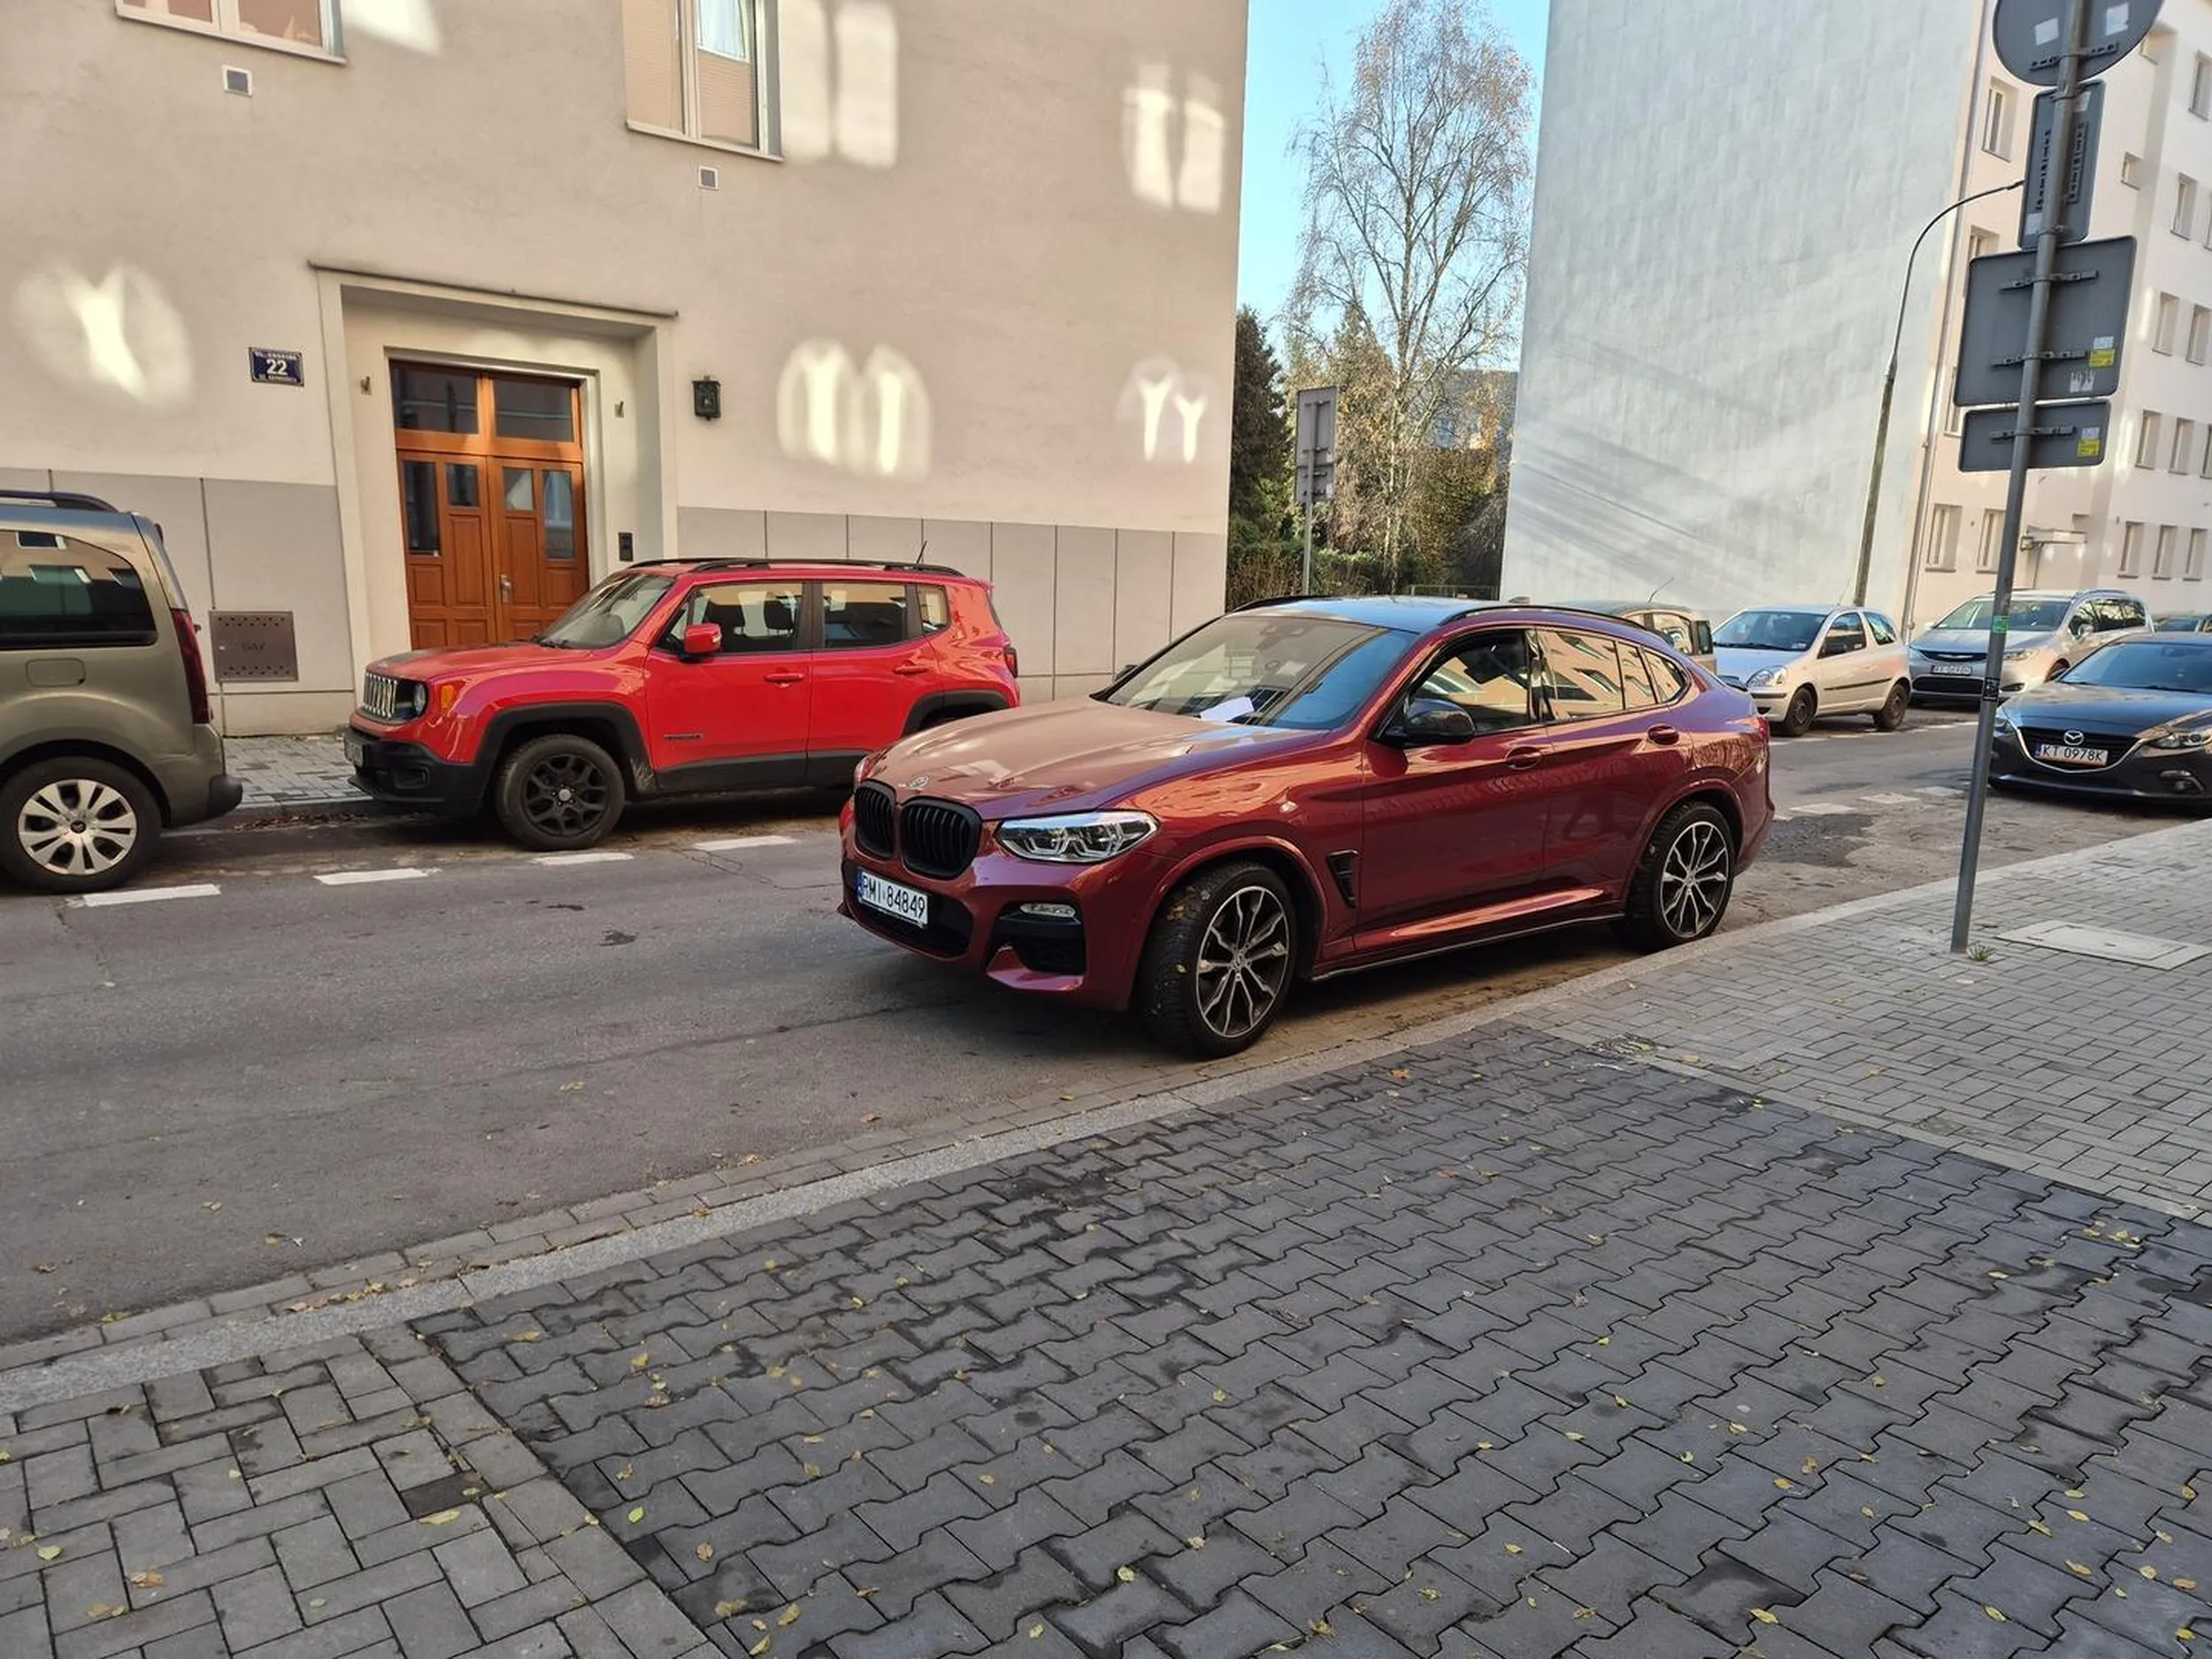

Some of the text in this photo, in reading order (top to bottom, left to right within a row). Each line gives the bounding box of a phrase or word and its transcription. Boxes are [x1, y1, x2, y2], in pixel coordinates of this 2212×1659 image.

[266, 358, 288, 375] 22
[2063, 747, 2103, 762] 0978K
[887, 885, 926, 919] 84849
